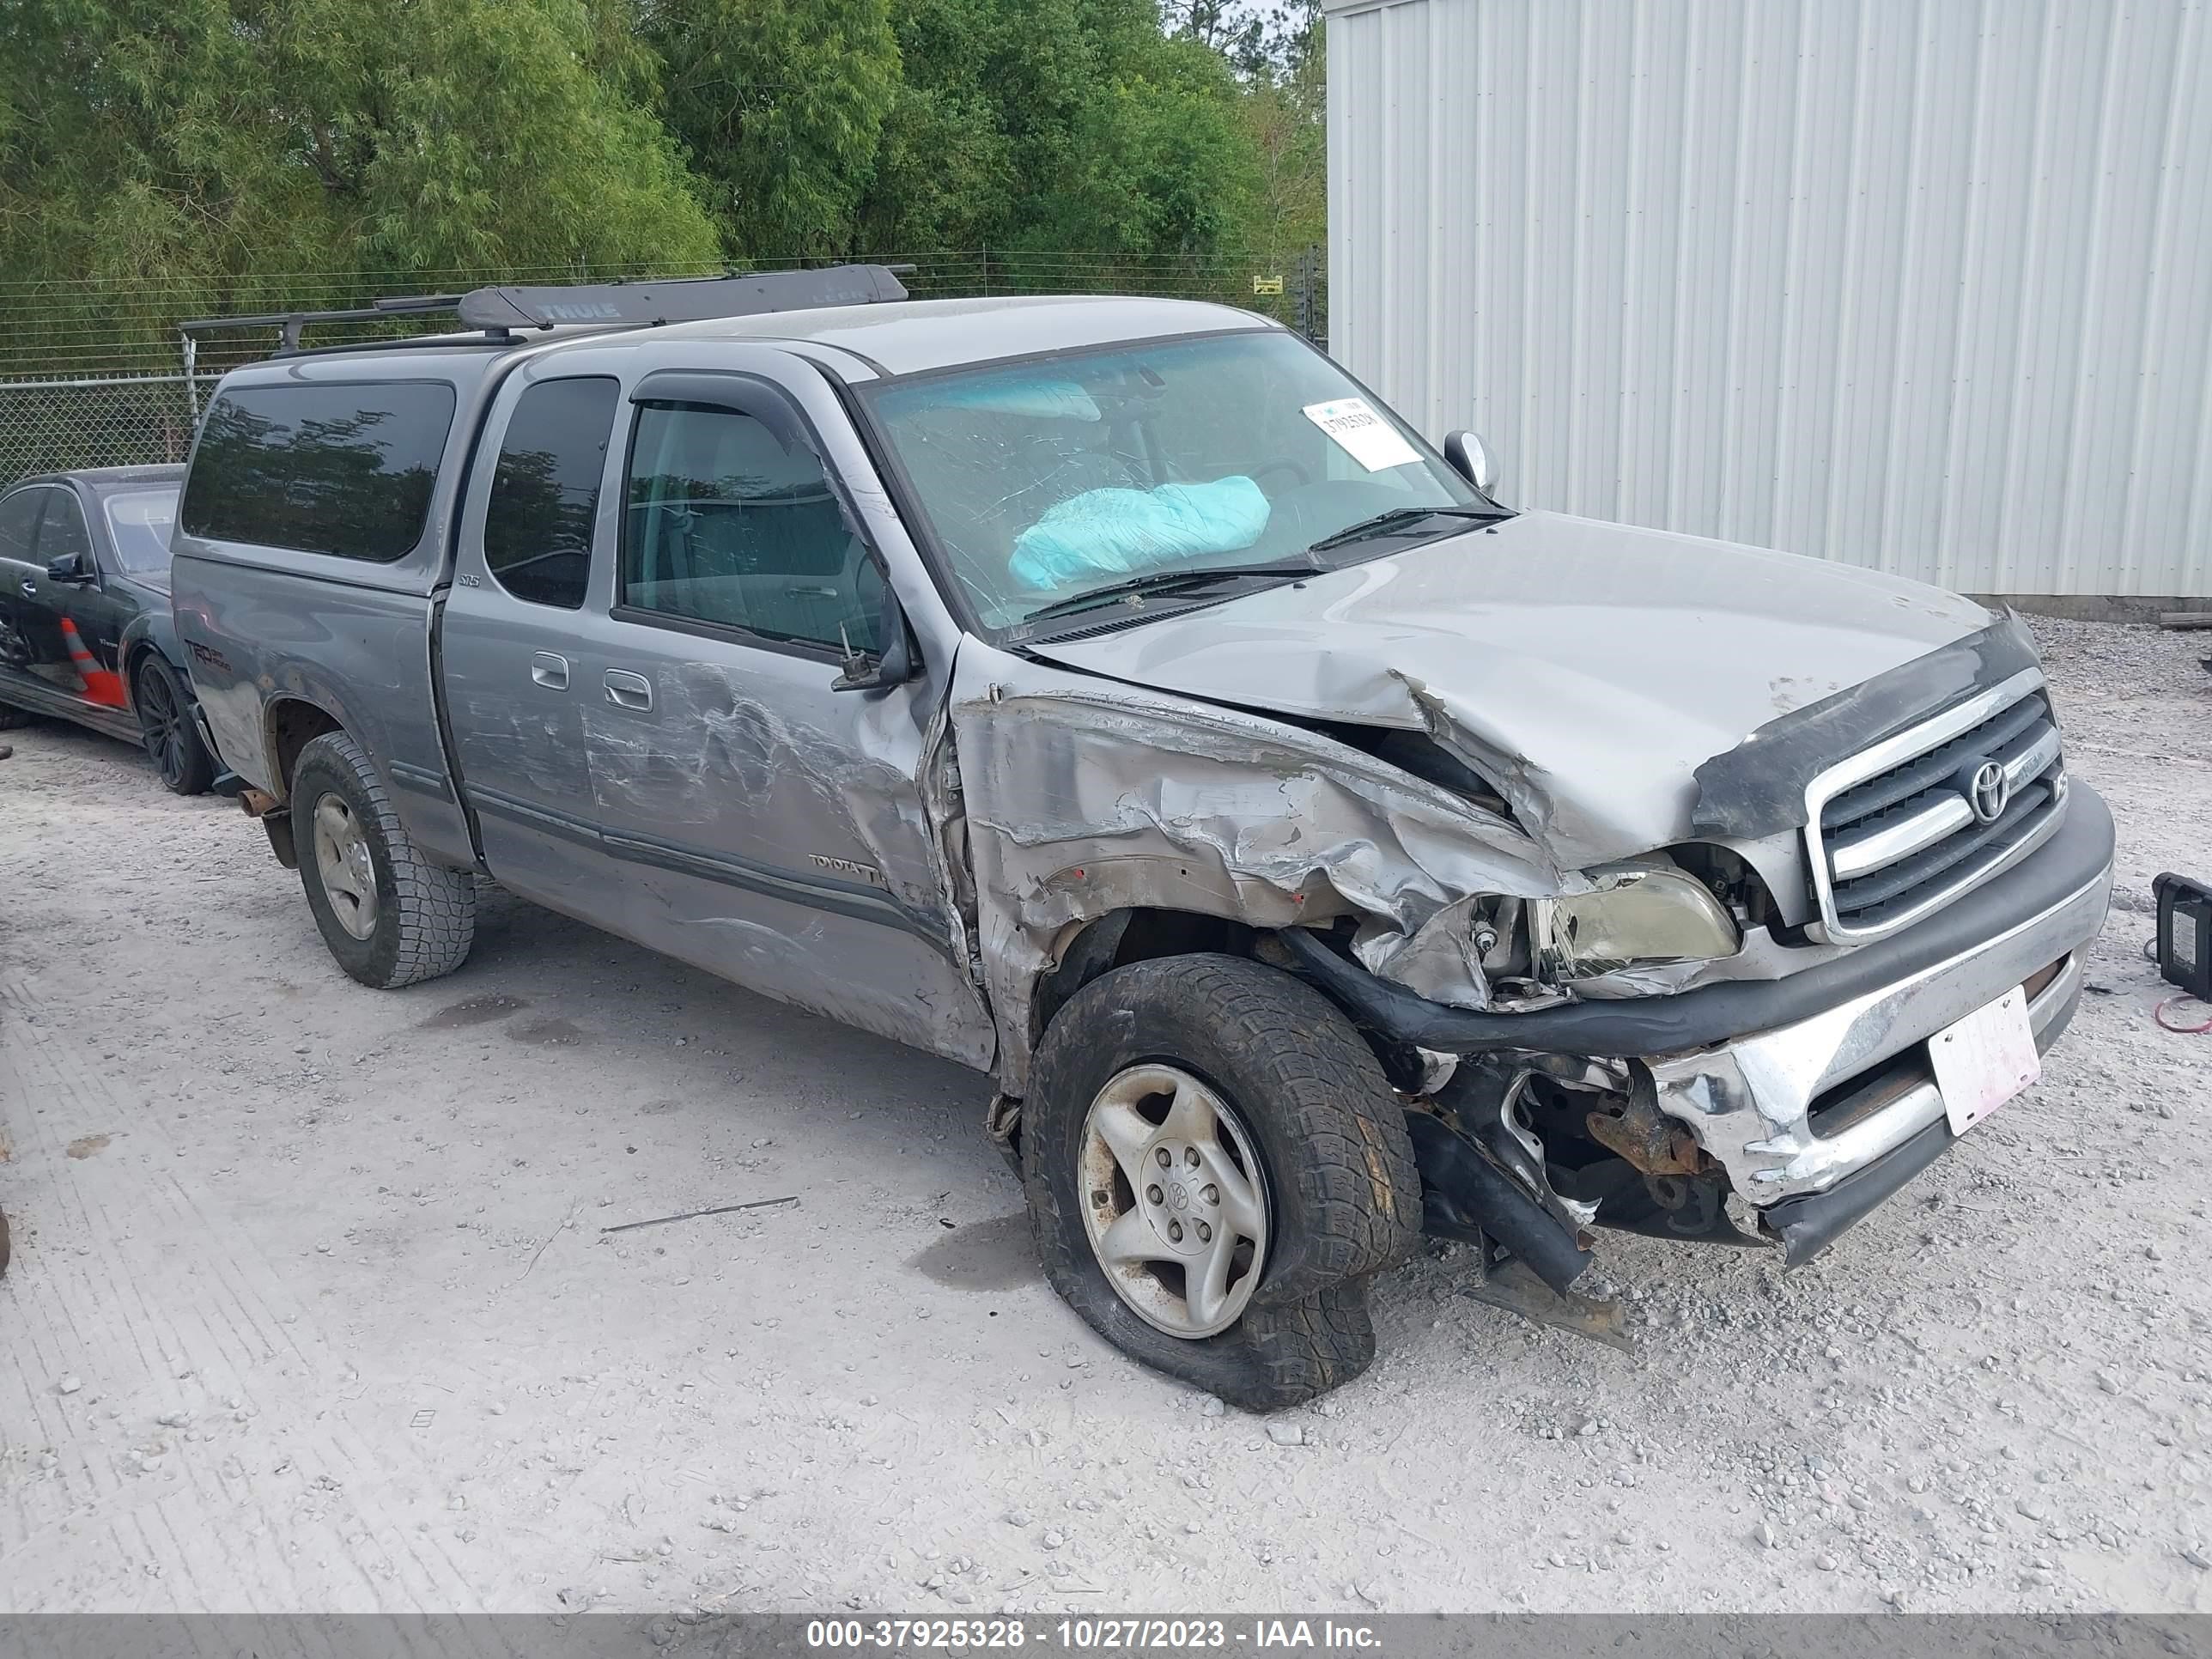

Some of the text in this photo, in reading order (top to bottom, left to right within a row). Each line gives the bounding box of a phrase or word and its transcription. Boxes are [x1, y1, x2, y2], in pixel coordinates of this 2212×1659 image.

[535, 302, 622, 319] THULE
[1323, 413, 1378, 433] 37925328
[184, 638, 213, 665] TRD
[808, 853, 861, 875] TOYOTA
